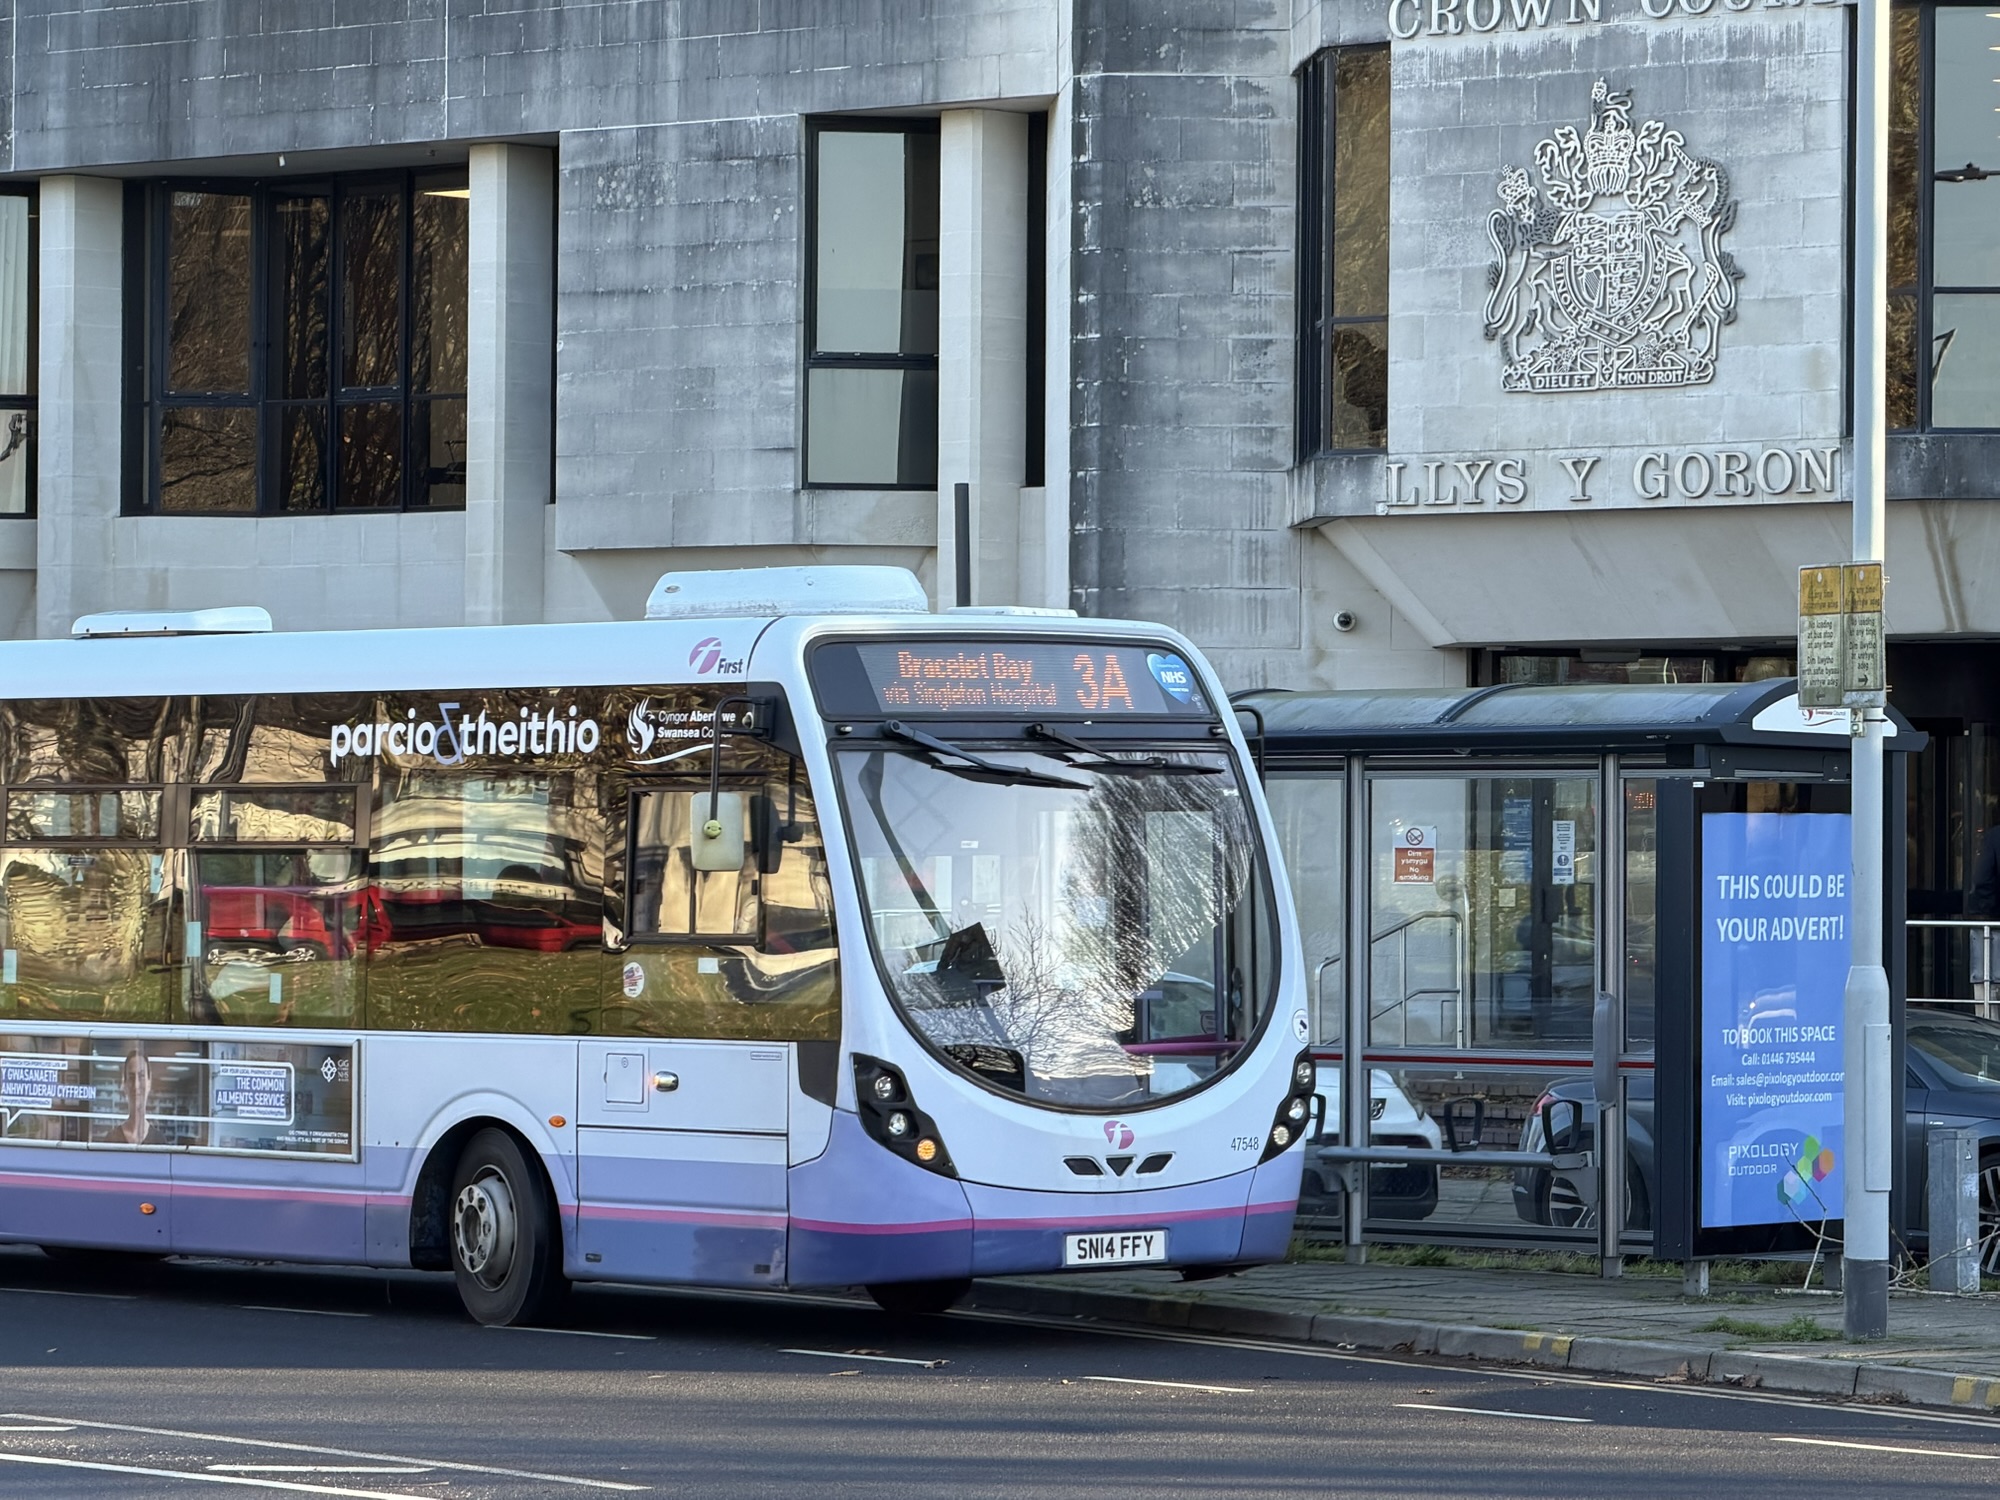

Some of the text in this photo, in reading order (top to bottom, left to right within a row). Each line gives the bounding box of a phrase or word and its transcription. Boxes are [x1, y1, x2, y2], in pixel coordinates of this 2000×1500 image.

[1535, 374, 1591, 389] DIEU ET
[1617, 370, 1684, 385] MON DROIT
[1386, 447, 1840, 506] LLYS Y GORON
[717, 658, 743, 674] First
[898, 651, 1032, 686] Bracelet Bay
[1073, 653, 1134, 709] 3A
[1160, 671, 1187, 684] NHS
[883, 681, 1057, 711] via Singleton Hospital
[657, 710, 688, 725] Cyngor
[657, 727, 700, 738] Swansea
[1717, 874, 1845, 900] THIS COULD BE
[1716, 914, 1844, 943] YOUR ADVERT!
[1722, 1025, 1836, 1045] TO BOOK THIS SPACE
[1741, 1051, 1816, 1066] Call: 01446 795444
[7, 1067, 58, 1082] GWASANAETH
[1711, 1073, 1735, 1087] Email:
[1, 1081, 97, 1099] ANHWYLDERAU CYFFREDIN
[236, 1077, 286, 1092] THE COMMON
[216, 1091, 286, 1107] AILMENTS SERVICE
[1726, 1090, 1833, 1108] Visit: pixologyoutdoor.com
[1231, 1136, 1260, 1152] 47548
[1728, 1142, 1799, 1160] PIXOLOGY
[1728, 1163, 1777, 1177] OUTDOOR
[1077, 1234, 1155, 1260] SN14 FFY
